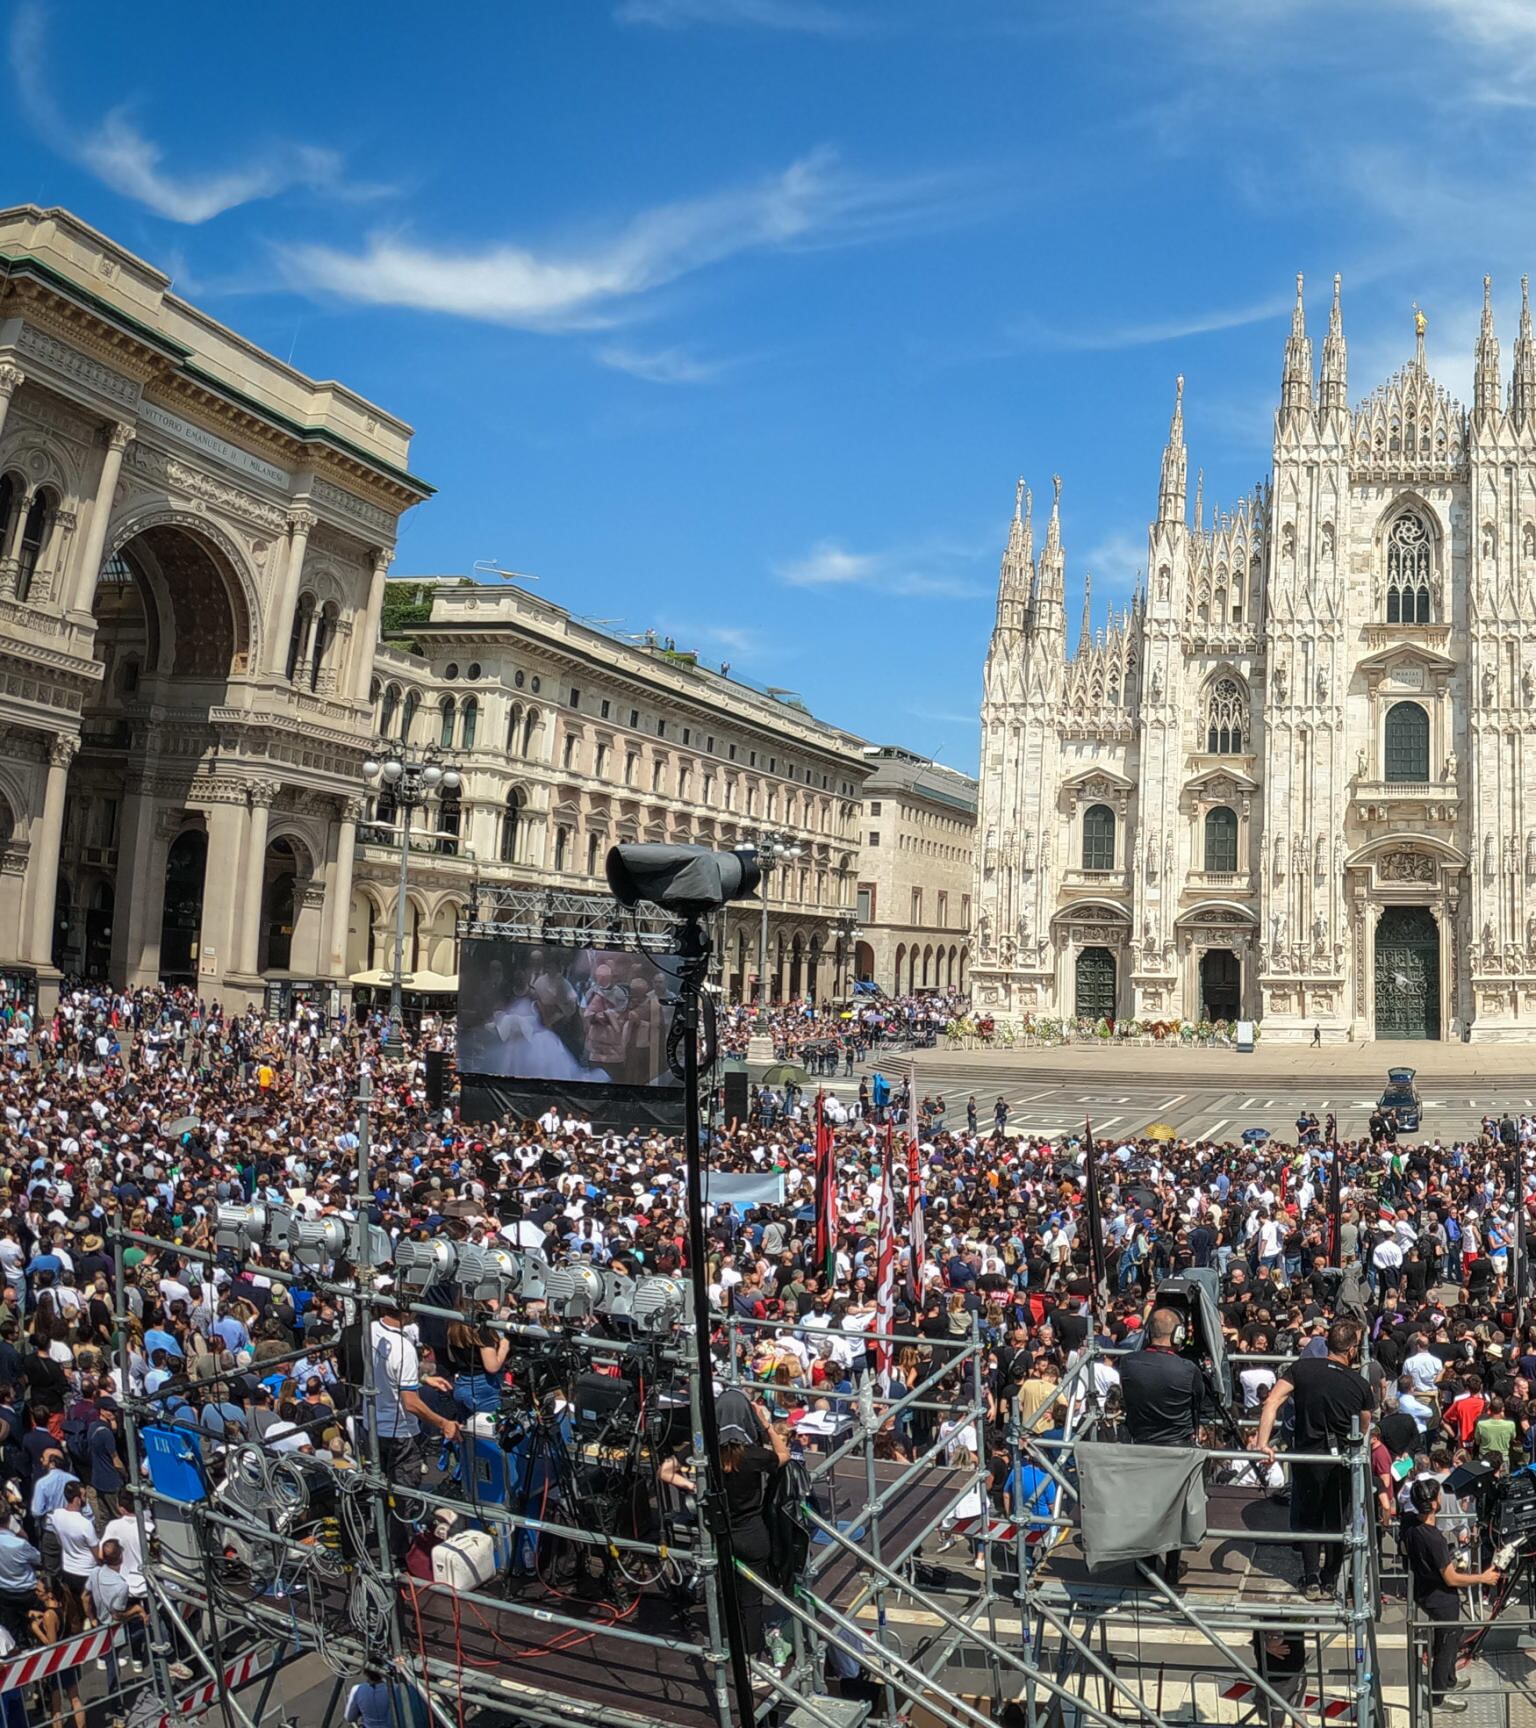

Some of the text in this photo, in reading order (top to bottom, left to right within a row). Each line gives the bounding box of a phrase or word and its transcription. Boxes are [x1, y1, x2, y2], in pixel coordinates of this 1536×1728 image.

[145, 406, 183, 432] VITTORIO
[186, 428, 228, 456] EMANUELE
[250, 460, 283, 482] MILANESI
